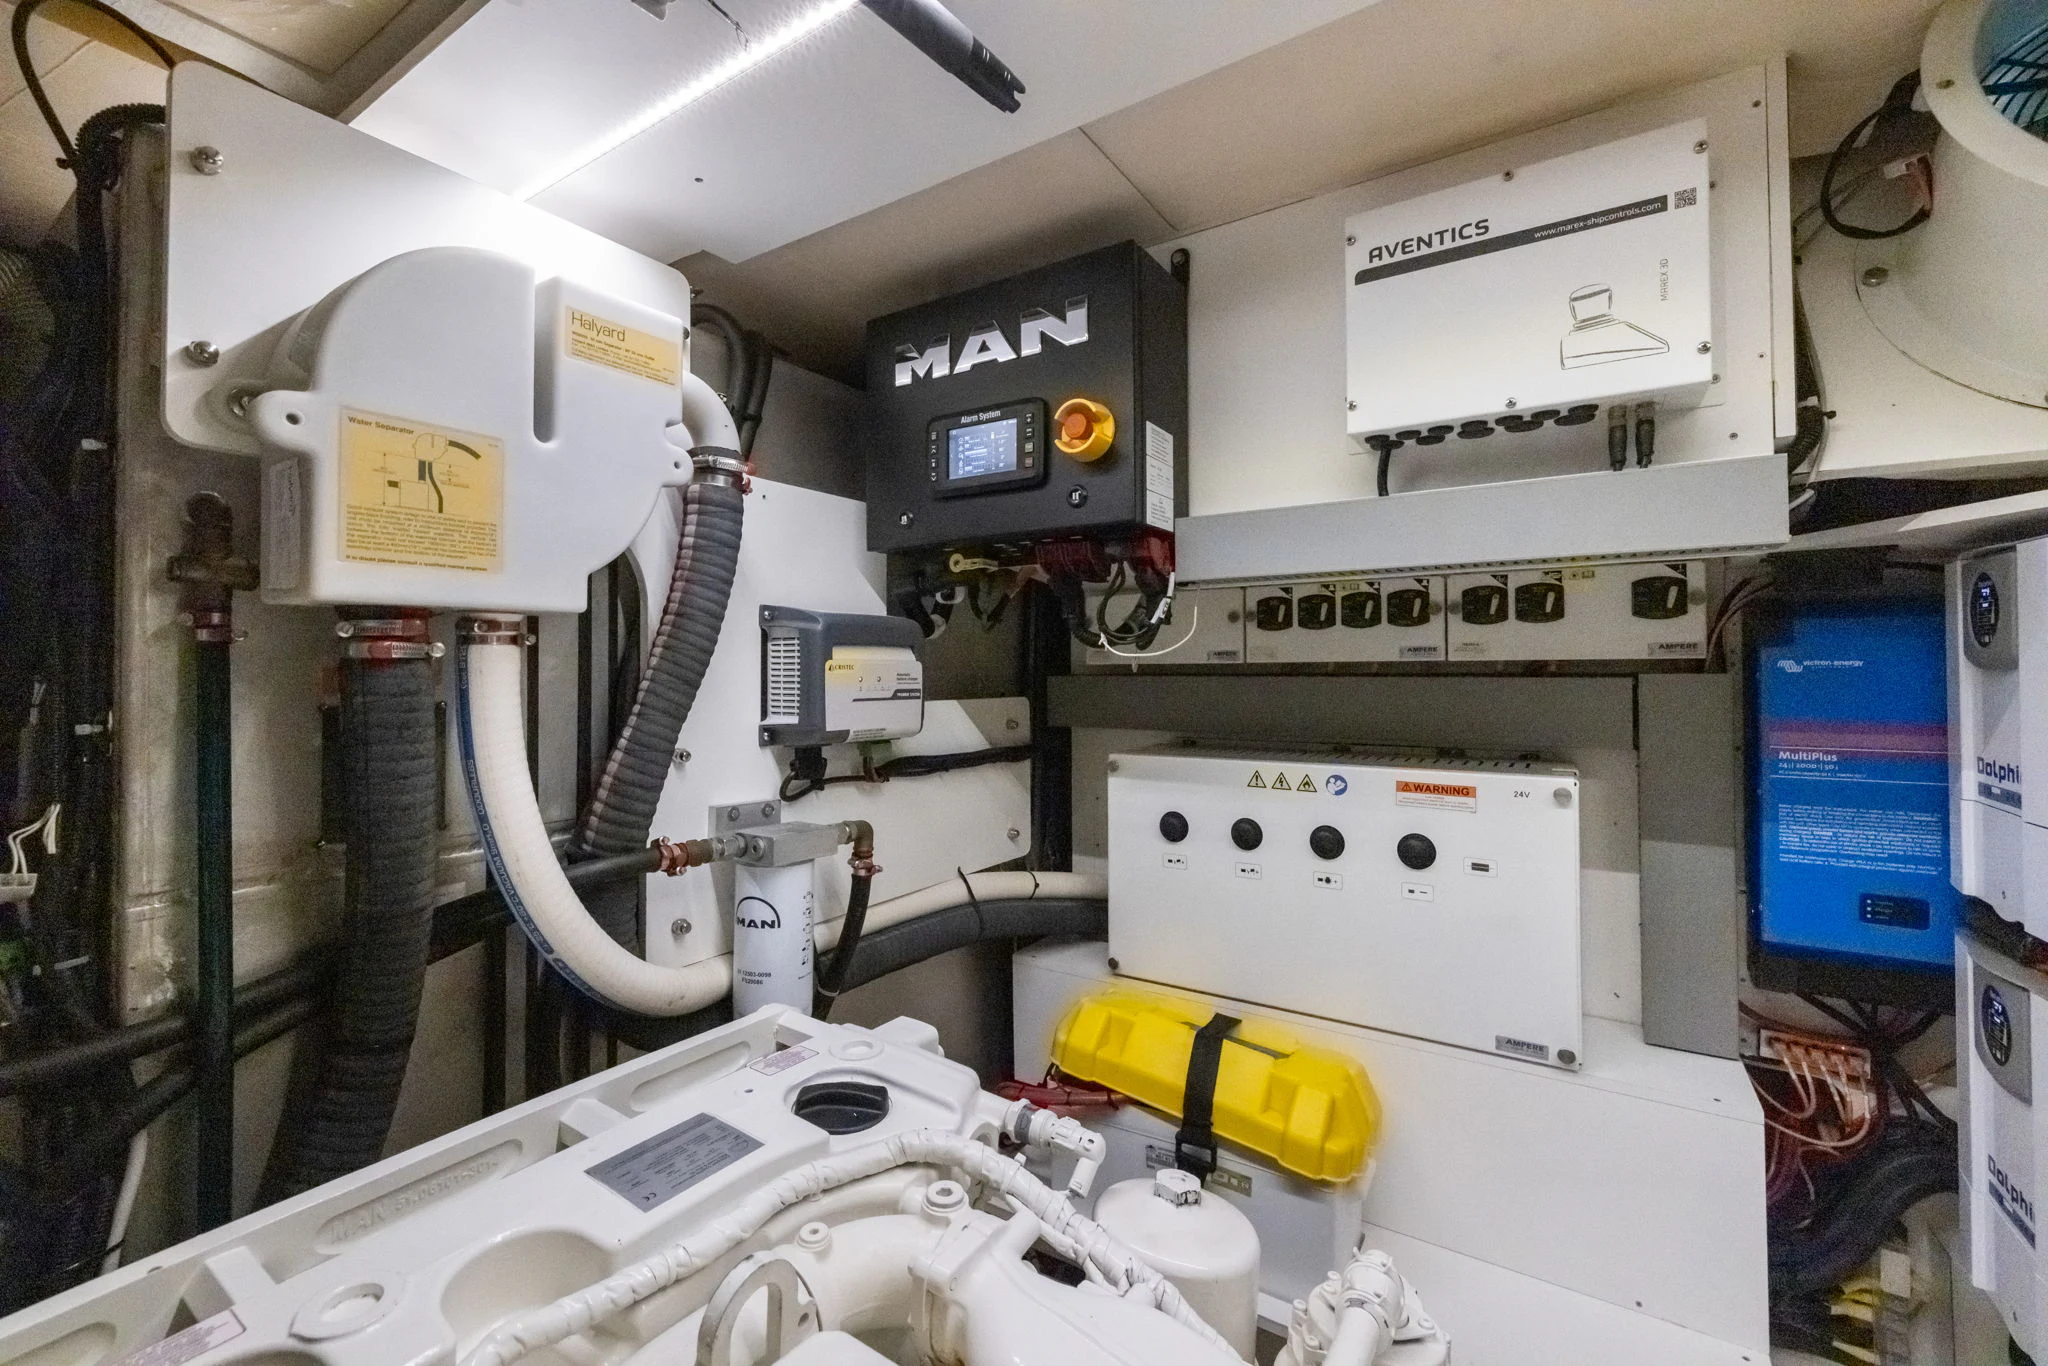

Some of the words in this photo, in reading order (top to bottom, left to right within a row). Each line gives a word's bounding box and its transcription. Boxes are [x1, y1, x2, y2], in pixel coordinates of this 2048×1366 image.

[1534, 202, 1662, 238] www.marex-shipcontrols.com
[1368, 218, 1490, 264] AVENTICS
[1660, 271, 1669, 302] MAREX
[571, 311, 626, 342] Halyard
[895, 294, 1089, 387] MAN
[347, 416, 373, 428] Water
[375, 420, 415, 435] Separator
[960, 415, 979, 424] Alarm
[979, 410, 1001, 421] System
[1778, 751, 1838, 762] MultiPlus
[1977, 756, 2021, 784] Dolphi
[1413, 783, 1470, 796] WARNING
[494, 856, 515, 895] VACUUM
[736, 917, 776, 929] MAN
[1505, 1038, 1545, 1052] AMPERE
[1987, 1152, 2034, 1223] Dolphi
